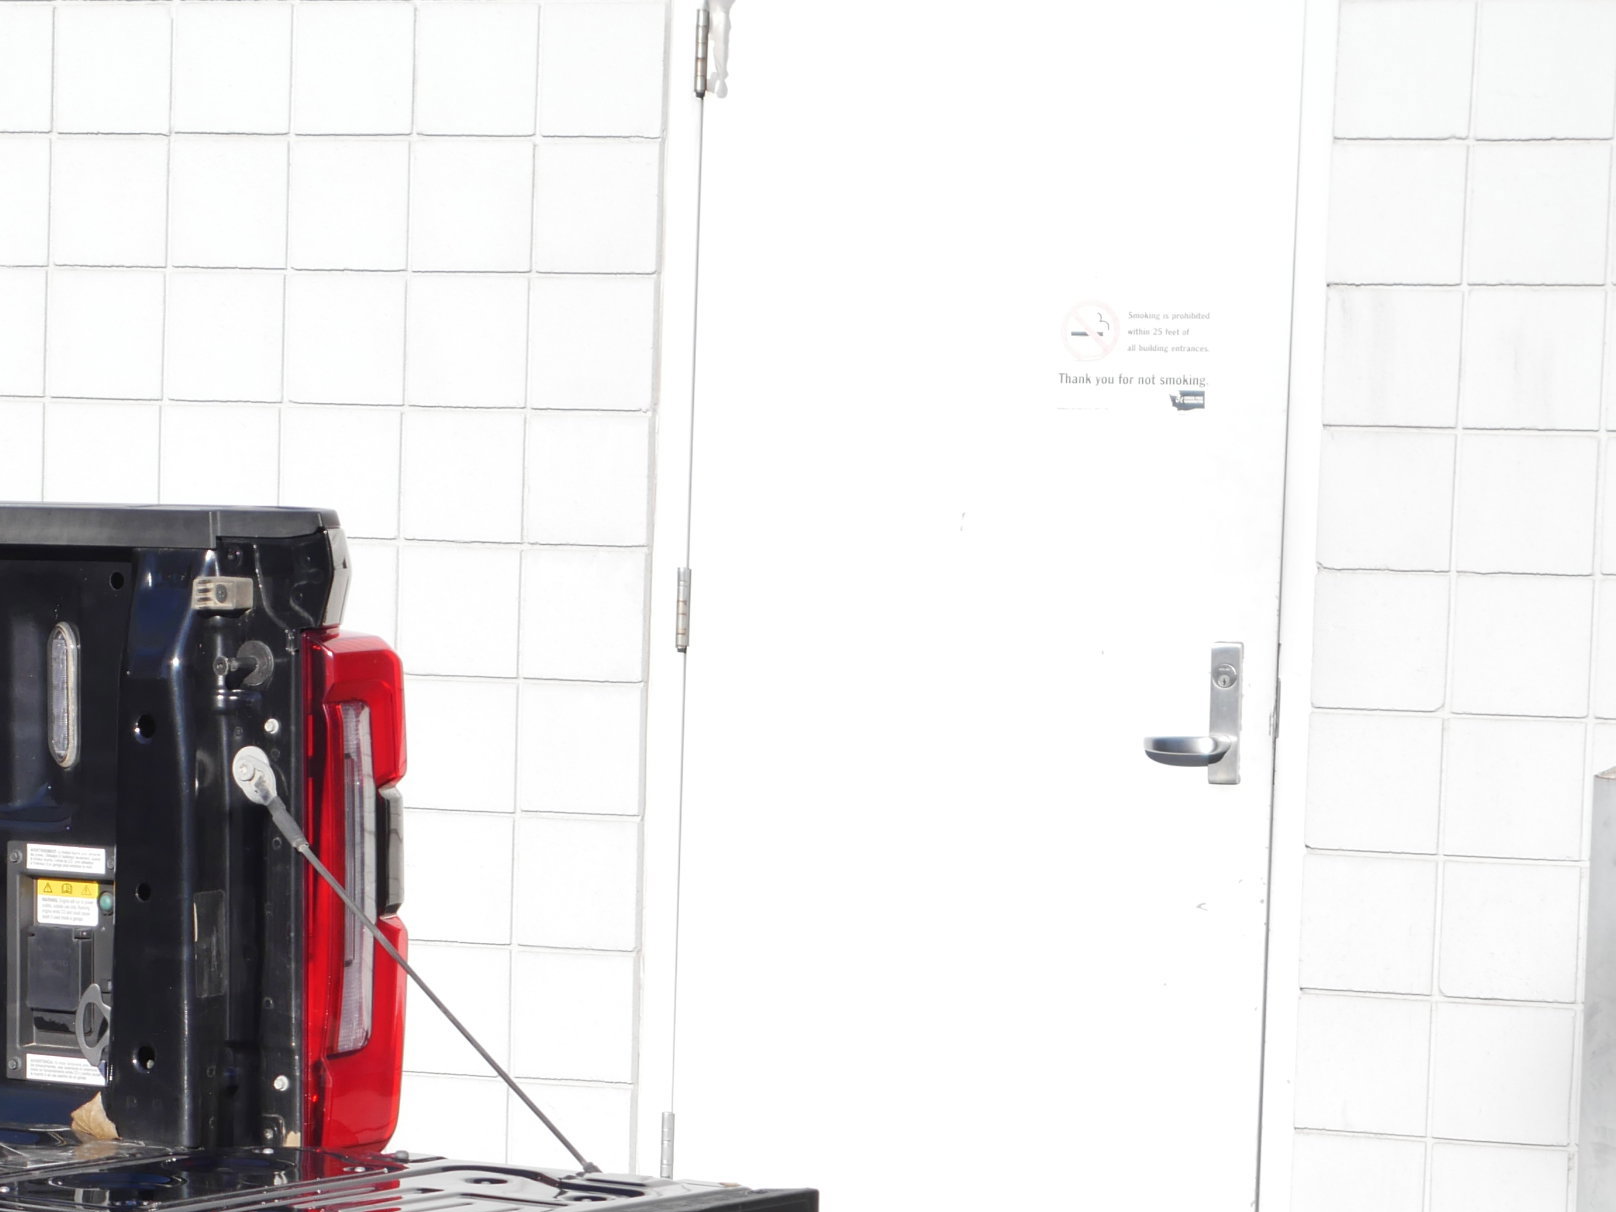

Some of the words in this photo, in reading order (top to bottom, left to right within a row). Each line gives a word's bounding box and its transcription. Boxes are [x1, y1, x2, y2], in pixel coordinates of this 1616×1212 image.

[1128, 312, 1160, 321] Smoking
[1163, 312, 1169, 320] is
[1172, 312, 1210, 321] prohibited
[1128, 328, 1150, 336] within
[1153, 328, 1163, 336] 25
[1165, 328, 1179, 336] feet
[1182, 328, 1190, 336] of
[1128, 344, 1136, 352] all
[1138, 344, 1168, 353] building
[1058, 372, 1092, 385] Thank
[1095, 375, 1114, 387] you
[1118, 373, 1134, 385] for
[1138, 374, 1156, 386] not
[1159, 374, 1209, 388] smoking.
